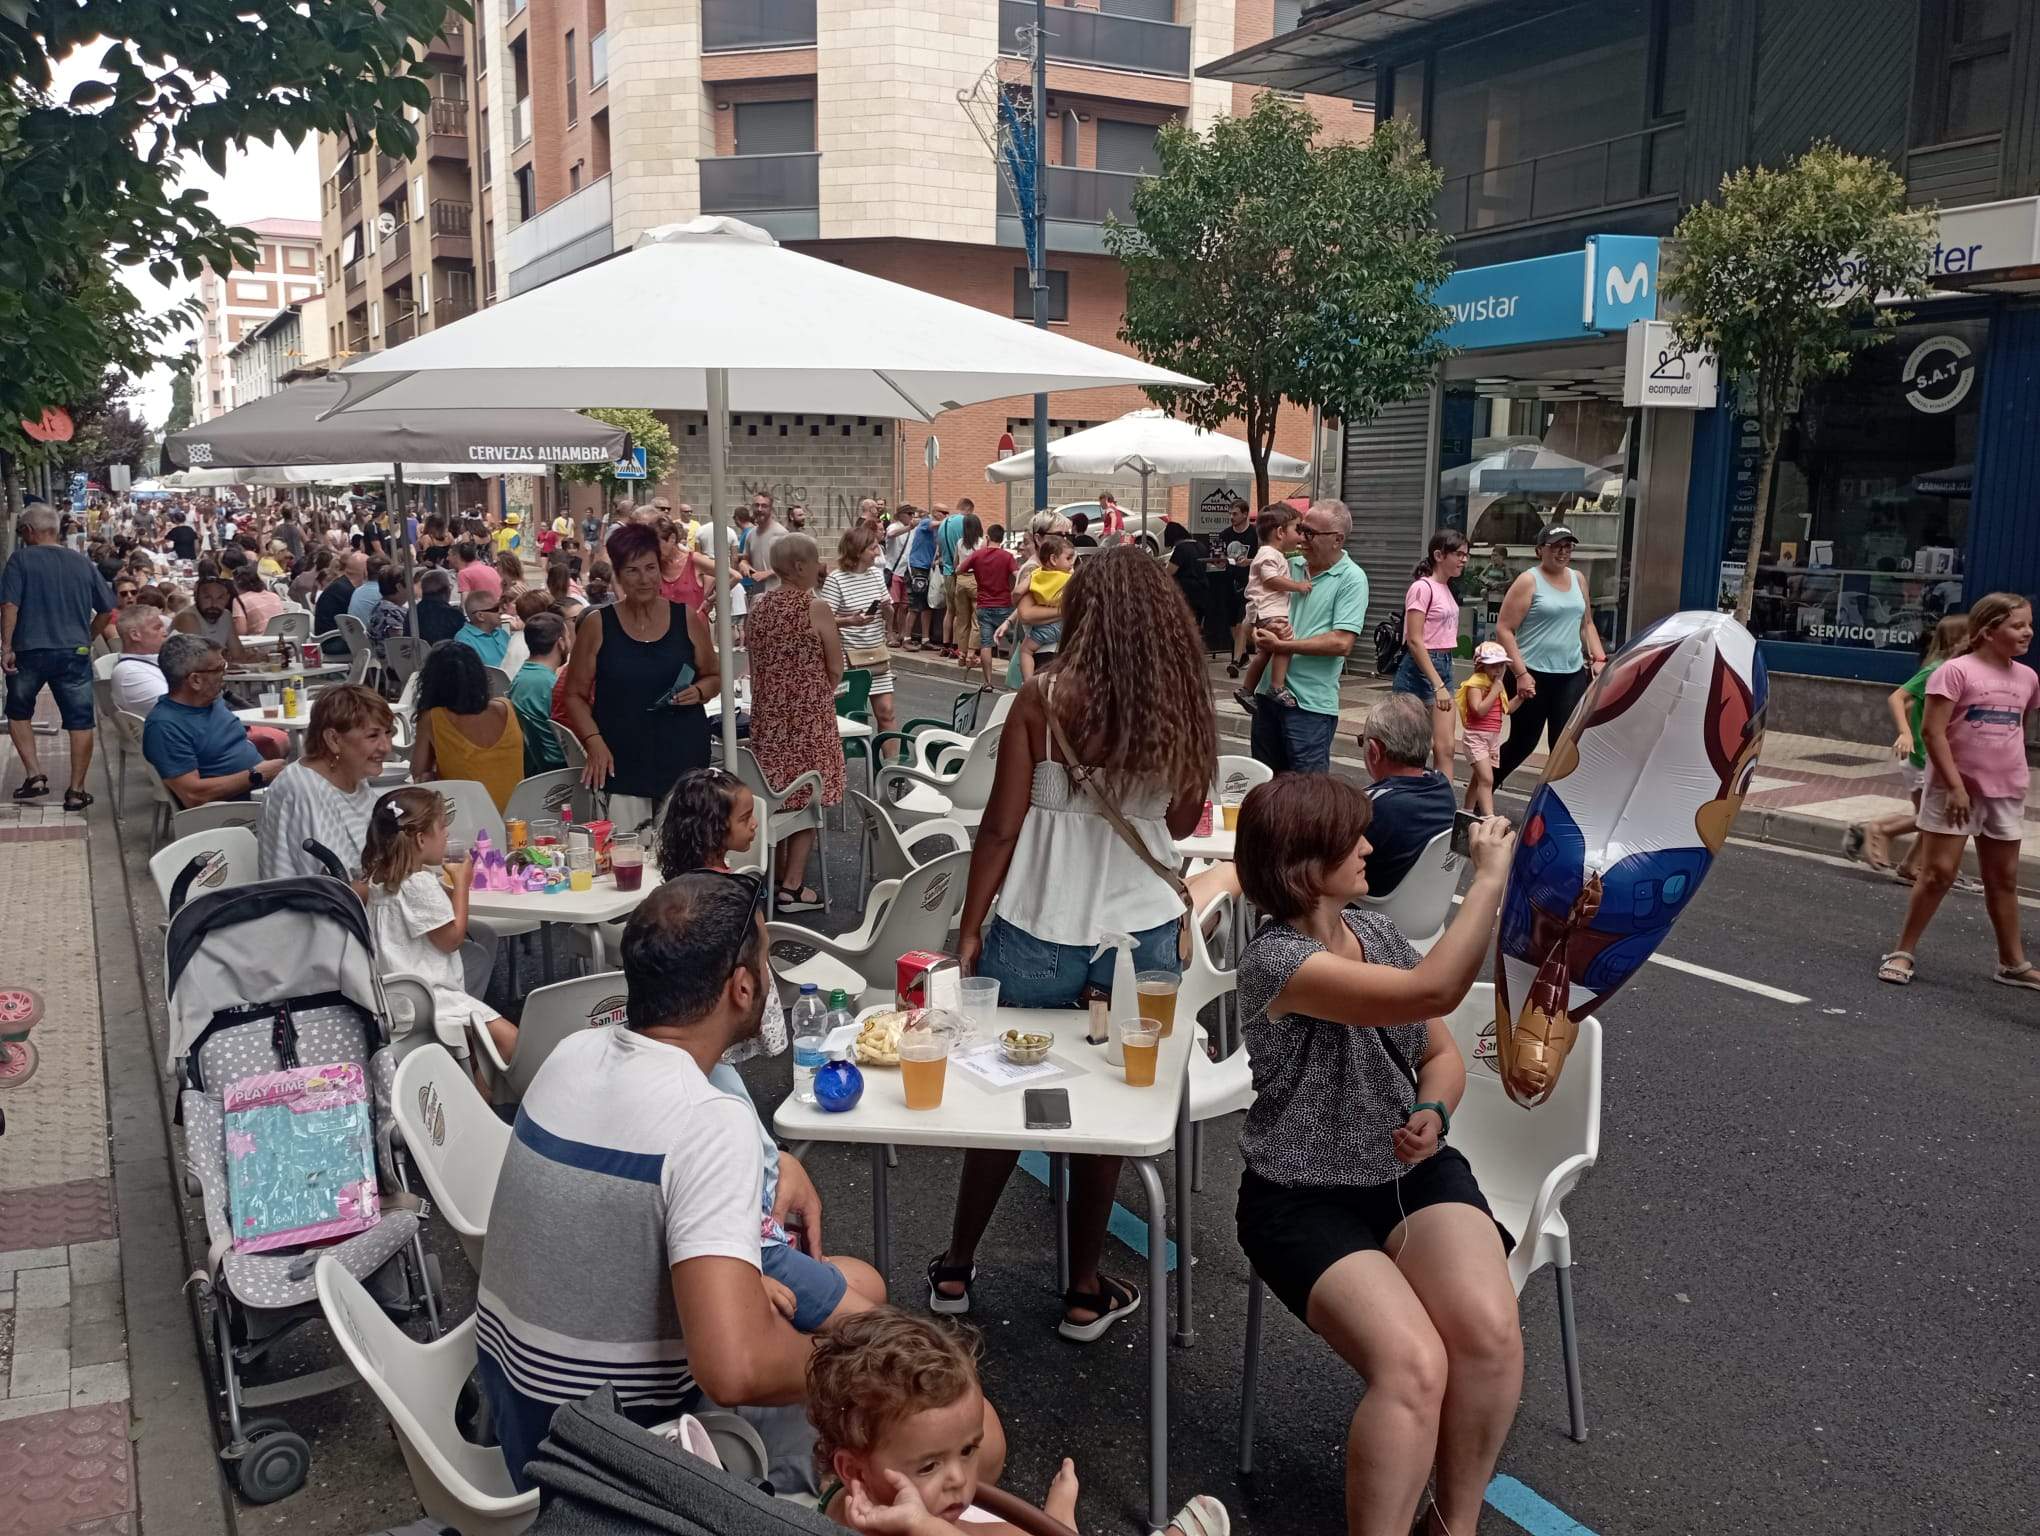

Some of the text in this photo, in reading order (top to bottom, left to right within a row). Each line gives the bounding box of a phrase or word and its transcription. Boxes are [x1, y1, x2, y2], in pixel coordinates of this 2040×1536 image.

[1648, 384, 1692, 397] ecomputer
[469, 446, 609, 460] CERVEZAS ALHAMBRA
[1201, 504, 1229, 512] MONTAÑ
[1809, 624, 1876, 640] SERVICIO
[235, 1081, 305, 1102] PLAY TIME
